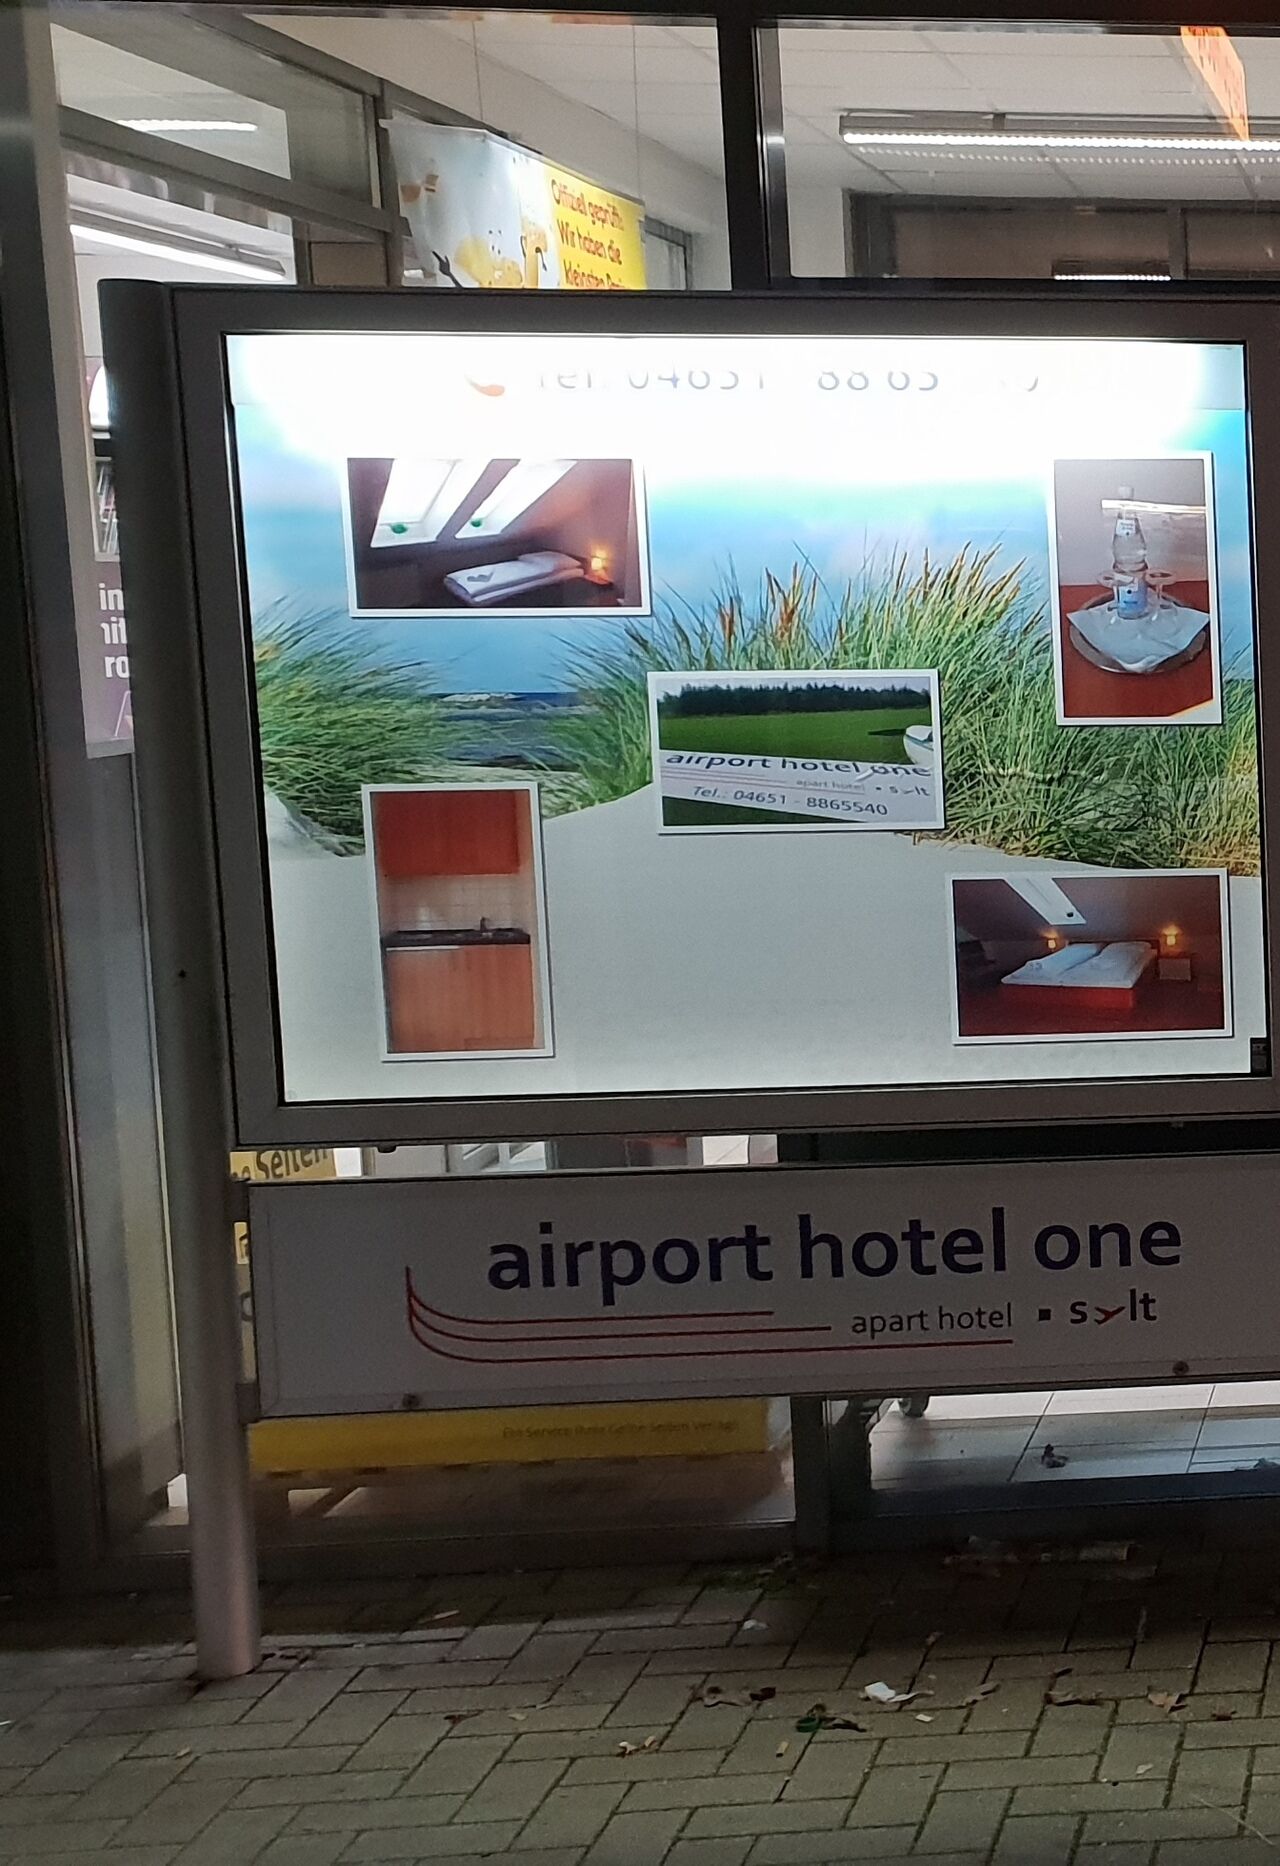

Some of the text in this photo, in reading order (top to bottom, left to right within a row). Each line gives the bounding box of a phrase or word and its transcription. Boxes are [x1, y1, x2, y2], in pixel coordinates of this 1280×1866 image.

[557, 218, 623, 266] Wir haben die
[666, 752, 932, 778] airport hotel one
[733, 790, 787, 806] 04651
[806, 797, 889, 816] 8865540
[487, 1206, 1182, 1307] airport hotel one
[851, 1288, 1158, 1340] apart hotel sylt
[526, 1425, 570, 1439] Service
